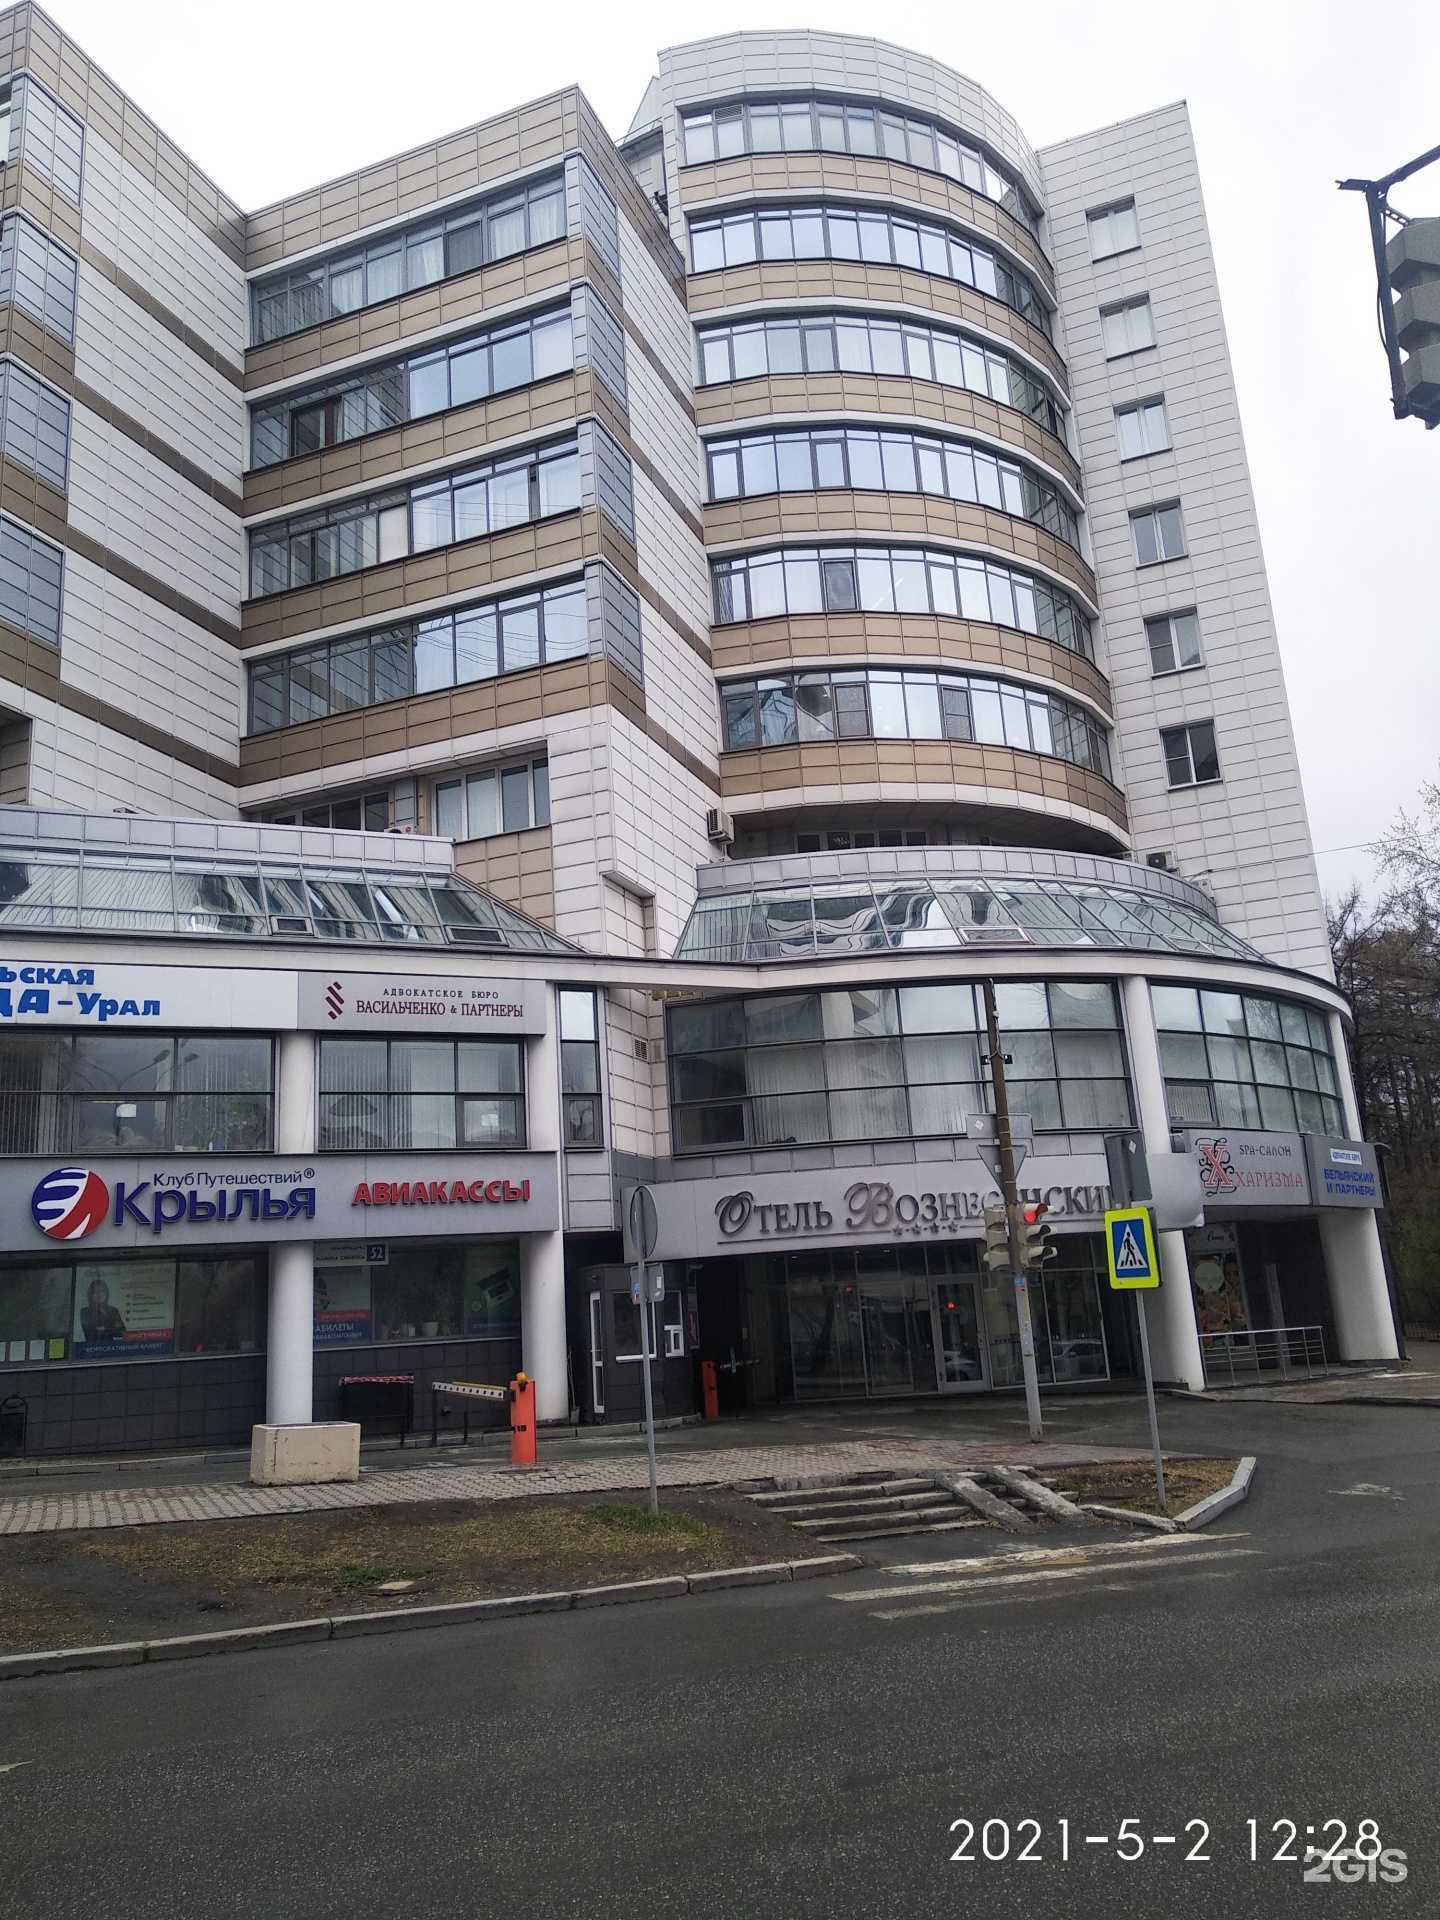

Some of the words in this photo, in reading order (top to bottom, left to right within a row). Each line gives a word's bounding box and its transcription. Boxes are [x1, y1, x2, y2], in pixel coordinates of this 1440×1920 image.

[383, 987, 463, 998] АДВОКАТСКОЕ
[471, 989, 499, 999] БЮРО
[356, 1000, 446, 1015] ВАСИЛЬЧЕНКО
[450, 1005, 457, 1014] &
[461, 1003, 524, 1017] ПАРТНЕРЫ
[153, 1172, 195, 1189] Клуб
[351, 1179, 531, 1206] АВИАКАССЫ
[1326, 1183, 1333, 1193] И
[1335, 1184, 1377, 1197] ПАРТНЕРЫ
[112, 1181, 317, 1234] Крылья
